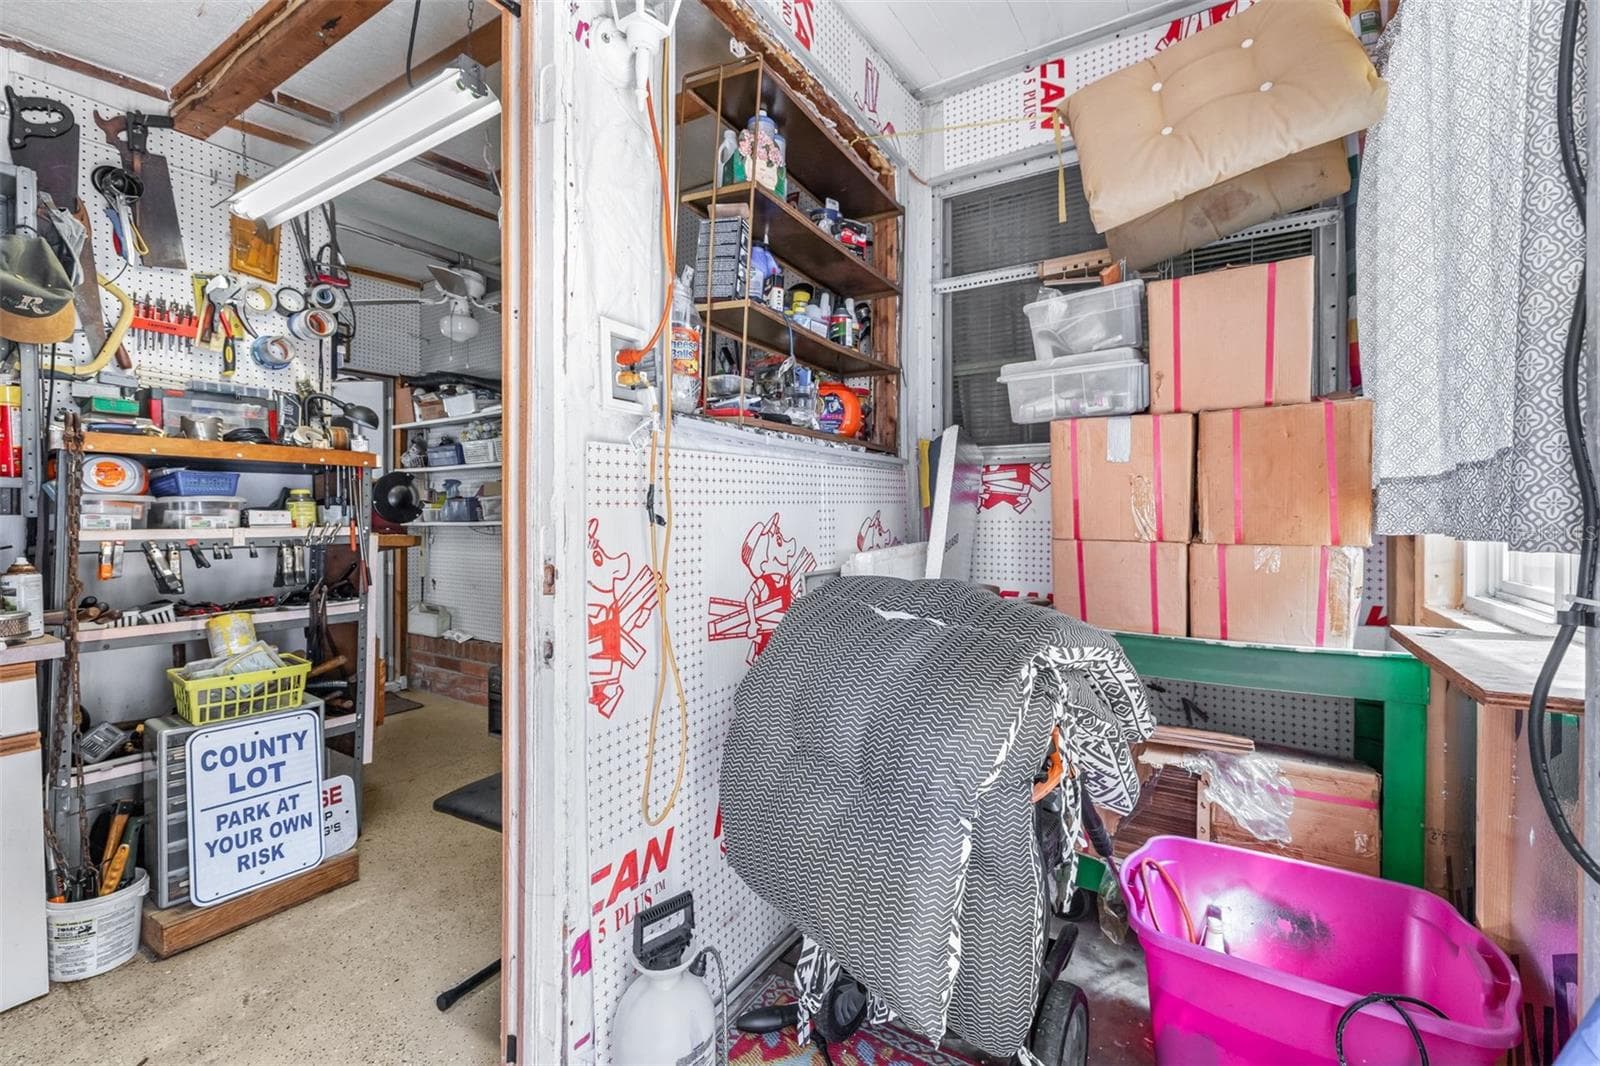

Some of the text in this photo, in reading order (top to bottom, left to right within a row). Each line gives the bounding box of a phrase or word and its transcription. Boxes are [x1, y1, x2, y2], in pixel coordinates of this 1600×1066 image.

[14, 294, 49, 314] R
[200, 730, 308, 772] COUNTY
[228, 760, 286, 794] LOT
[216, 794, 300, 832] PARK AT
[205, 812, 313, 858] YOUR OWN
[237, 843, 285, 873] RISK
[598, 918, 606, 944] 5
